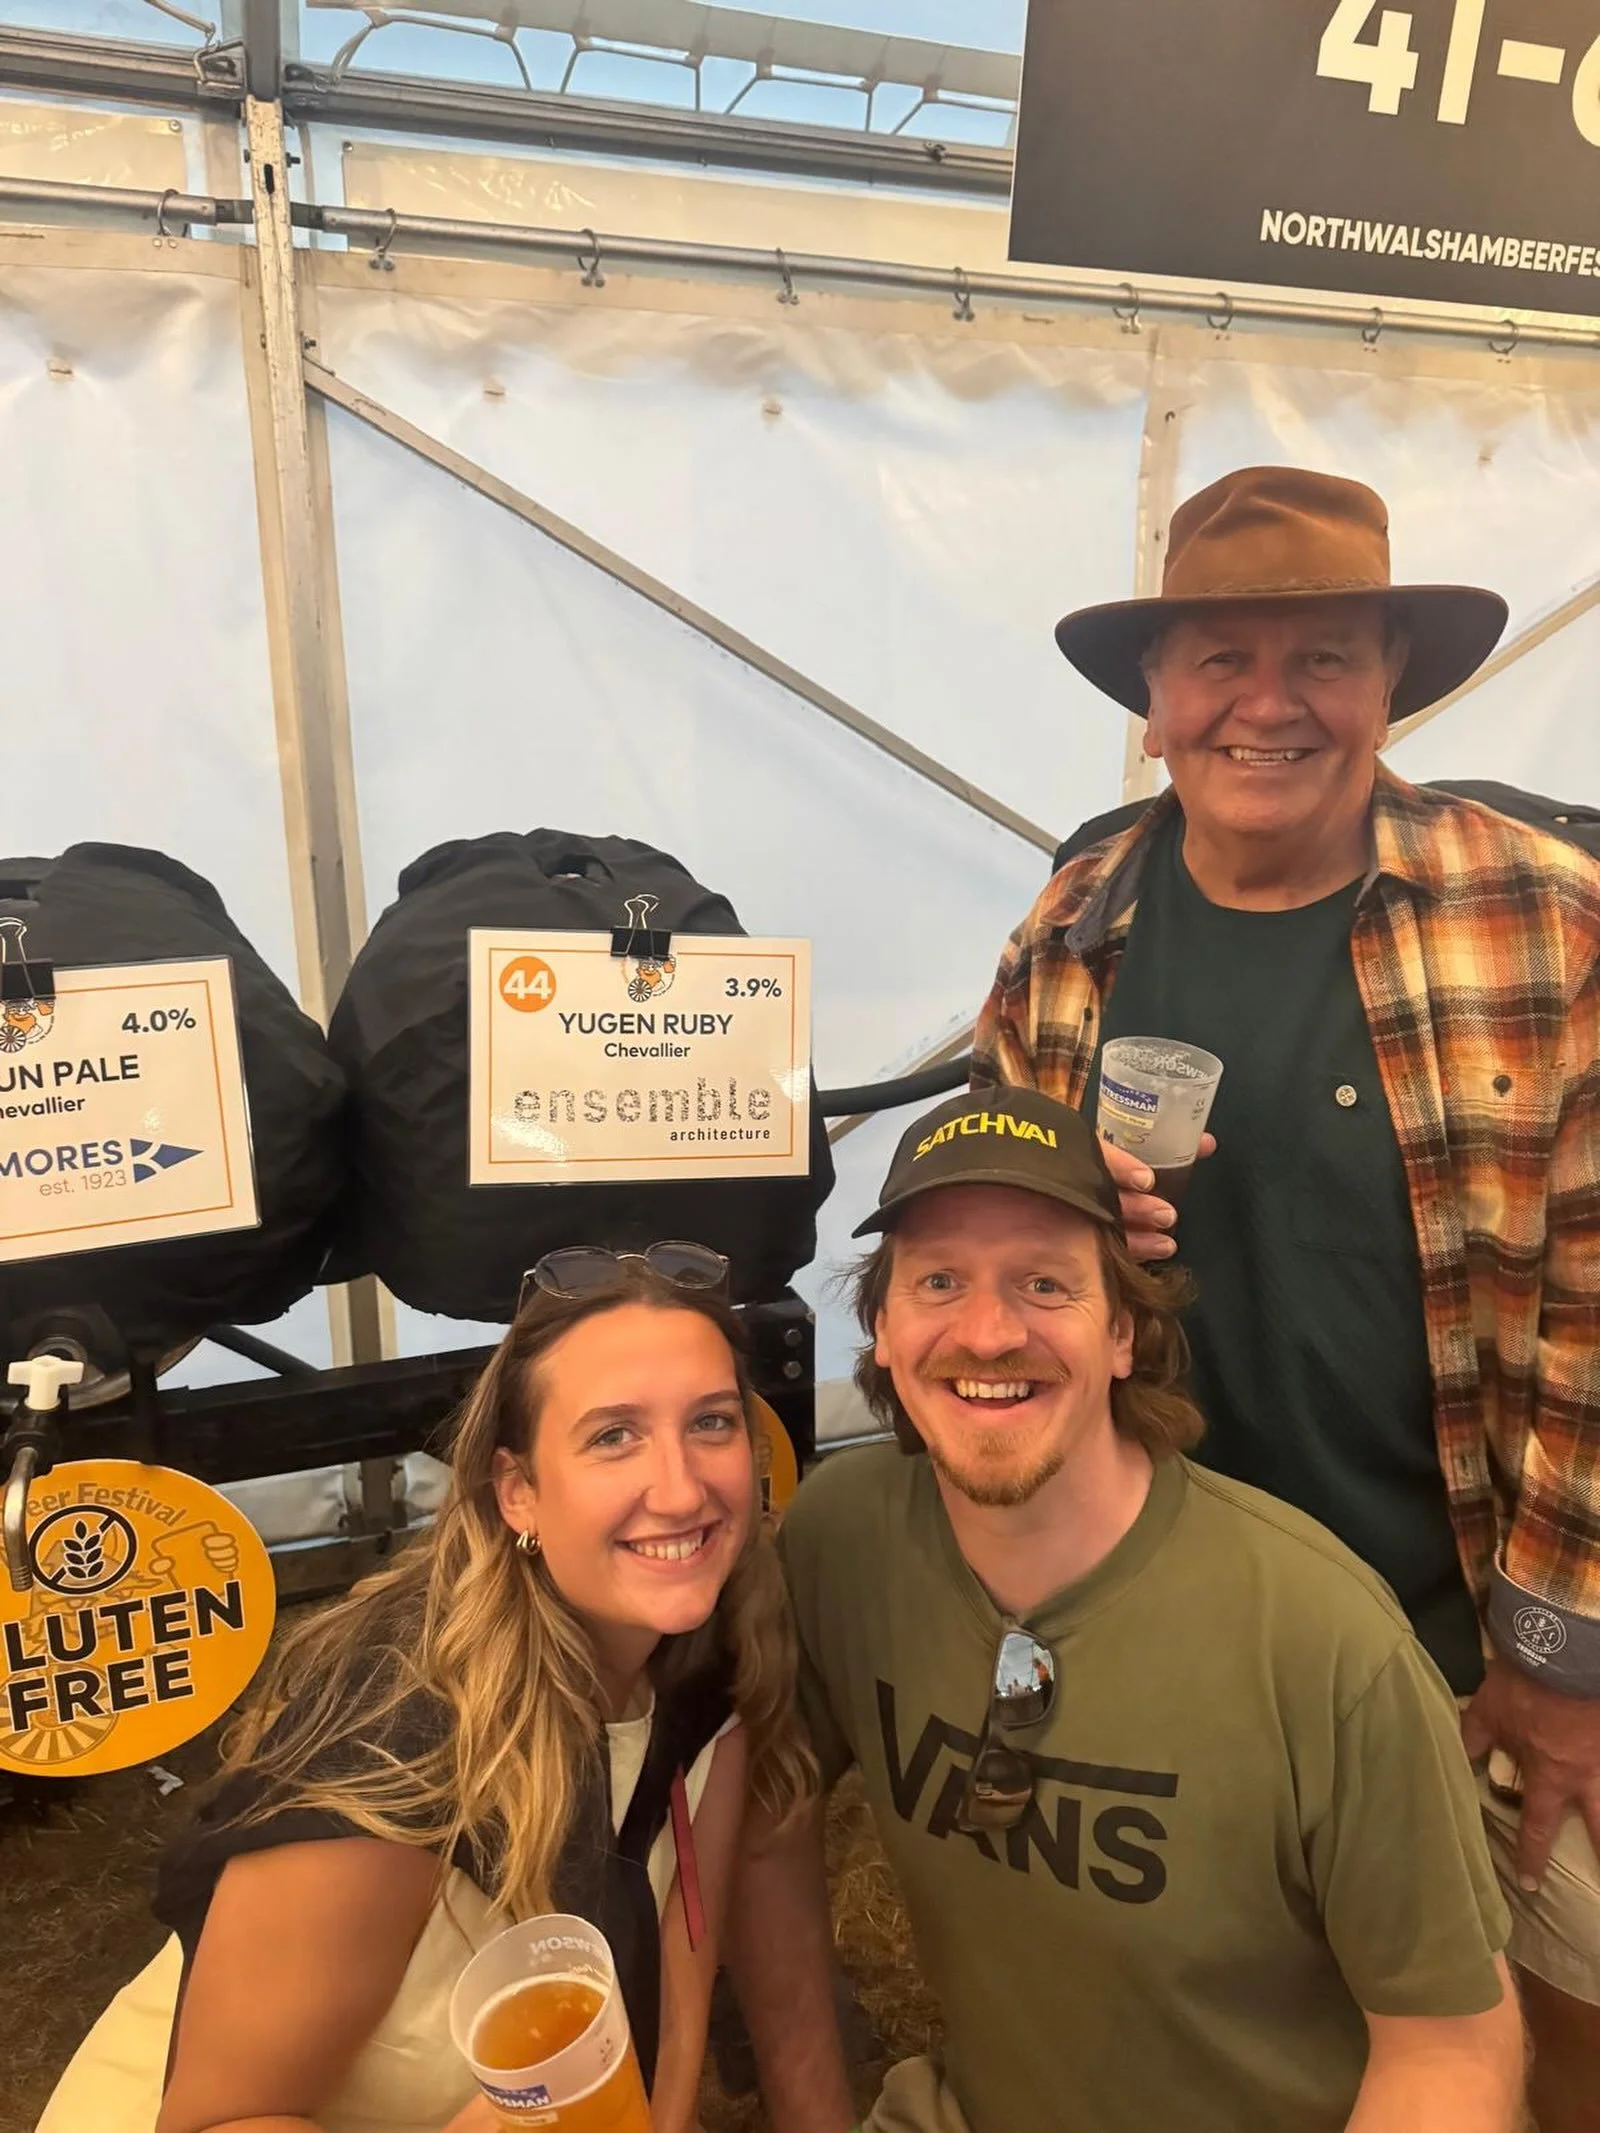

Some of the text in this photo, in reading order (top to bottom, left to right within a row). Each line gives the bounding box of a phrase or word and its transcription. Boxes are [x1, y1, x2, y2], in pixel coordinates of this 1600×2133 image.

[504, 969, 551, 1000] 44
[725, 978, 782, 998] 3.9%
[121, 1007, 197, 1034] 4.0%
[559, 1012, 733, 1035] YUGEN RUBY
[604, 1042, 690, 1058] Chevallier
[53, 1054, 140, 1087] PALE
[514, 1076, 771, 1123] ensemble
[670, 1127, 770, 1142] architecture
[912, 1112, 1058, 1162] SATCHVAI
[39, 1169, 127, 1197] est. 1923
[27, 1482, 187, 1527] eer Festival
[8, 1649, 194, 1732] FREE
